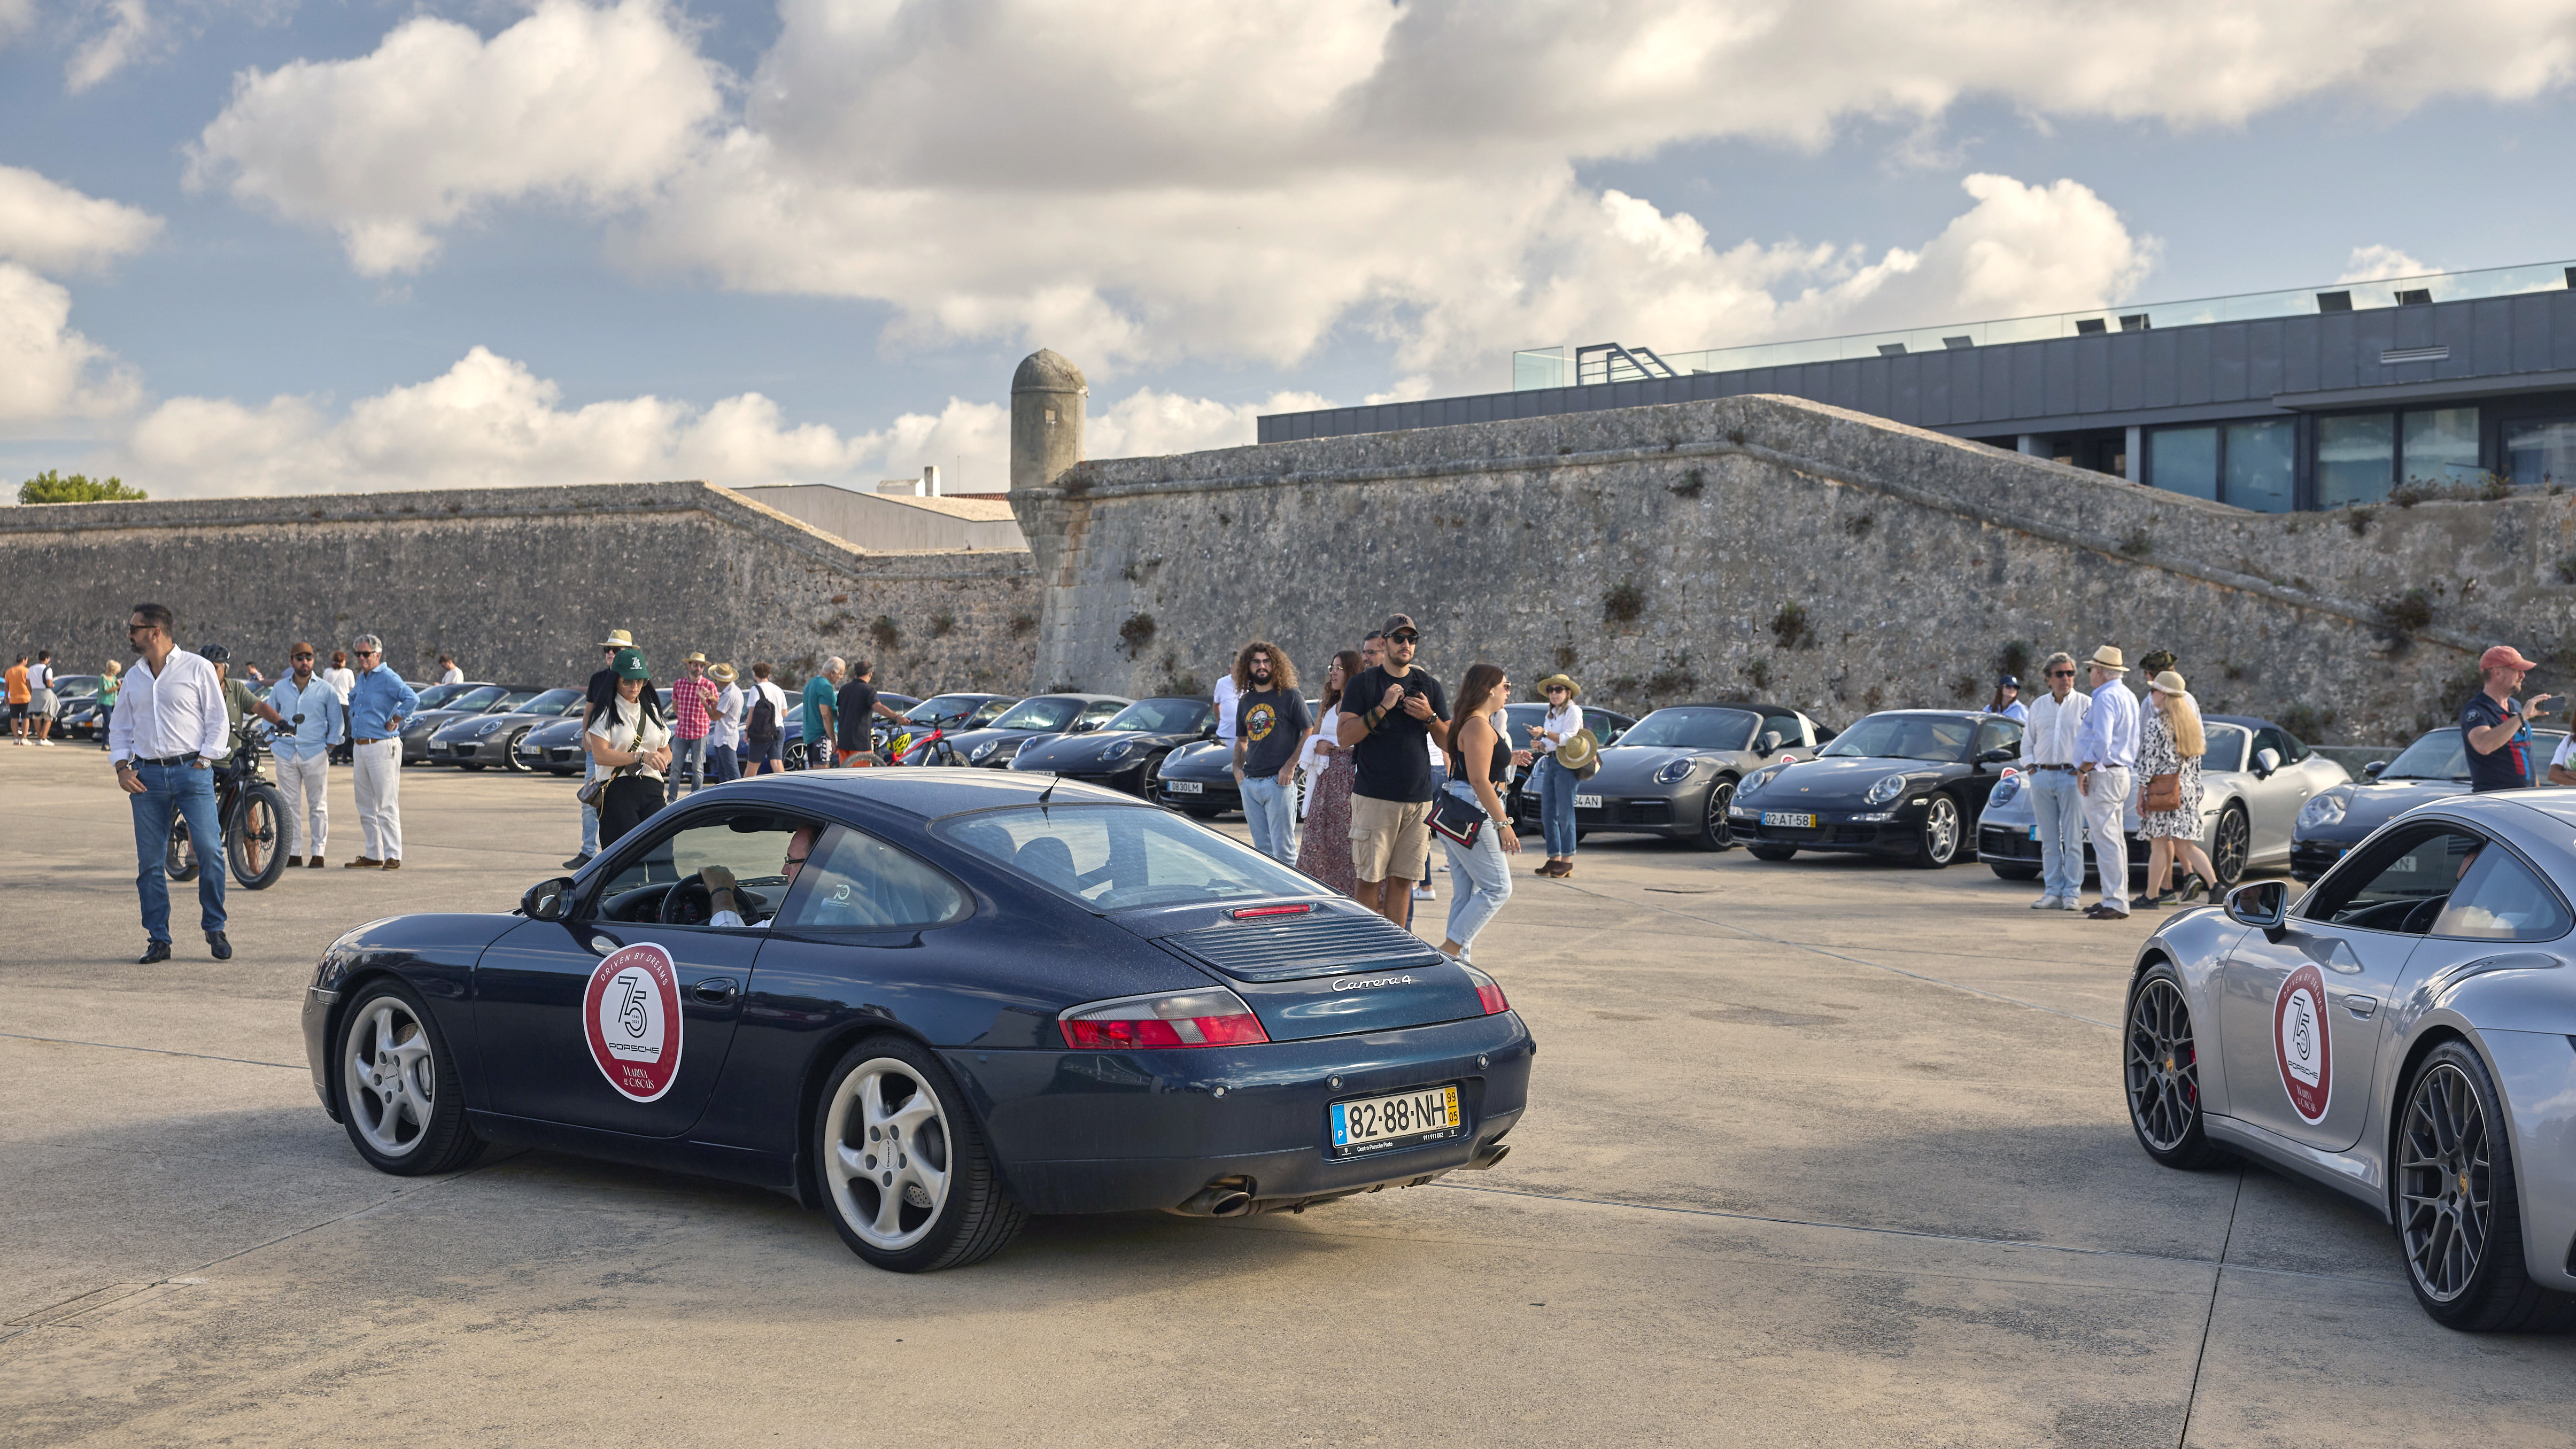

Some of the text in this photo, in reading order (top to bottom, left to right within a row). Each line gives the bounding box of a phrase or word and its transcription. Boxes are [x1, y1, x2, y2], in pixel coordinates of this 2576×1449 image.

[600, 954, 630, 981] DRIVEN
[646, 955, 668, 985] DREAMS
[1332, 975, 1412, 992] Carrera 4
[617, 975, 647, 1039] 75
[2293, 995, 2310, 1061] 75
[609, 1043, 660, 1054] PORSCHE
[2288, 1060, 2318, 1080] PORSCHE
[1447, 1092, 1456, 1102] 99
[1449, 1111, 1458, 1122] 05
[1338, 1130, 1343, 1139] P
